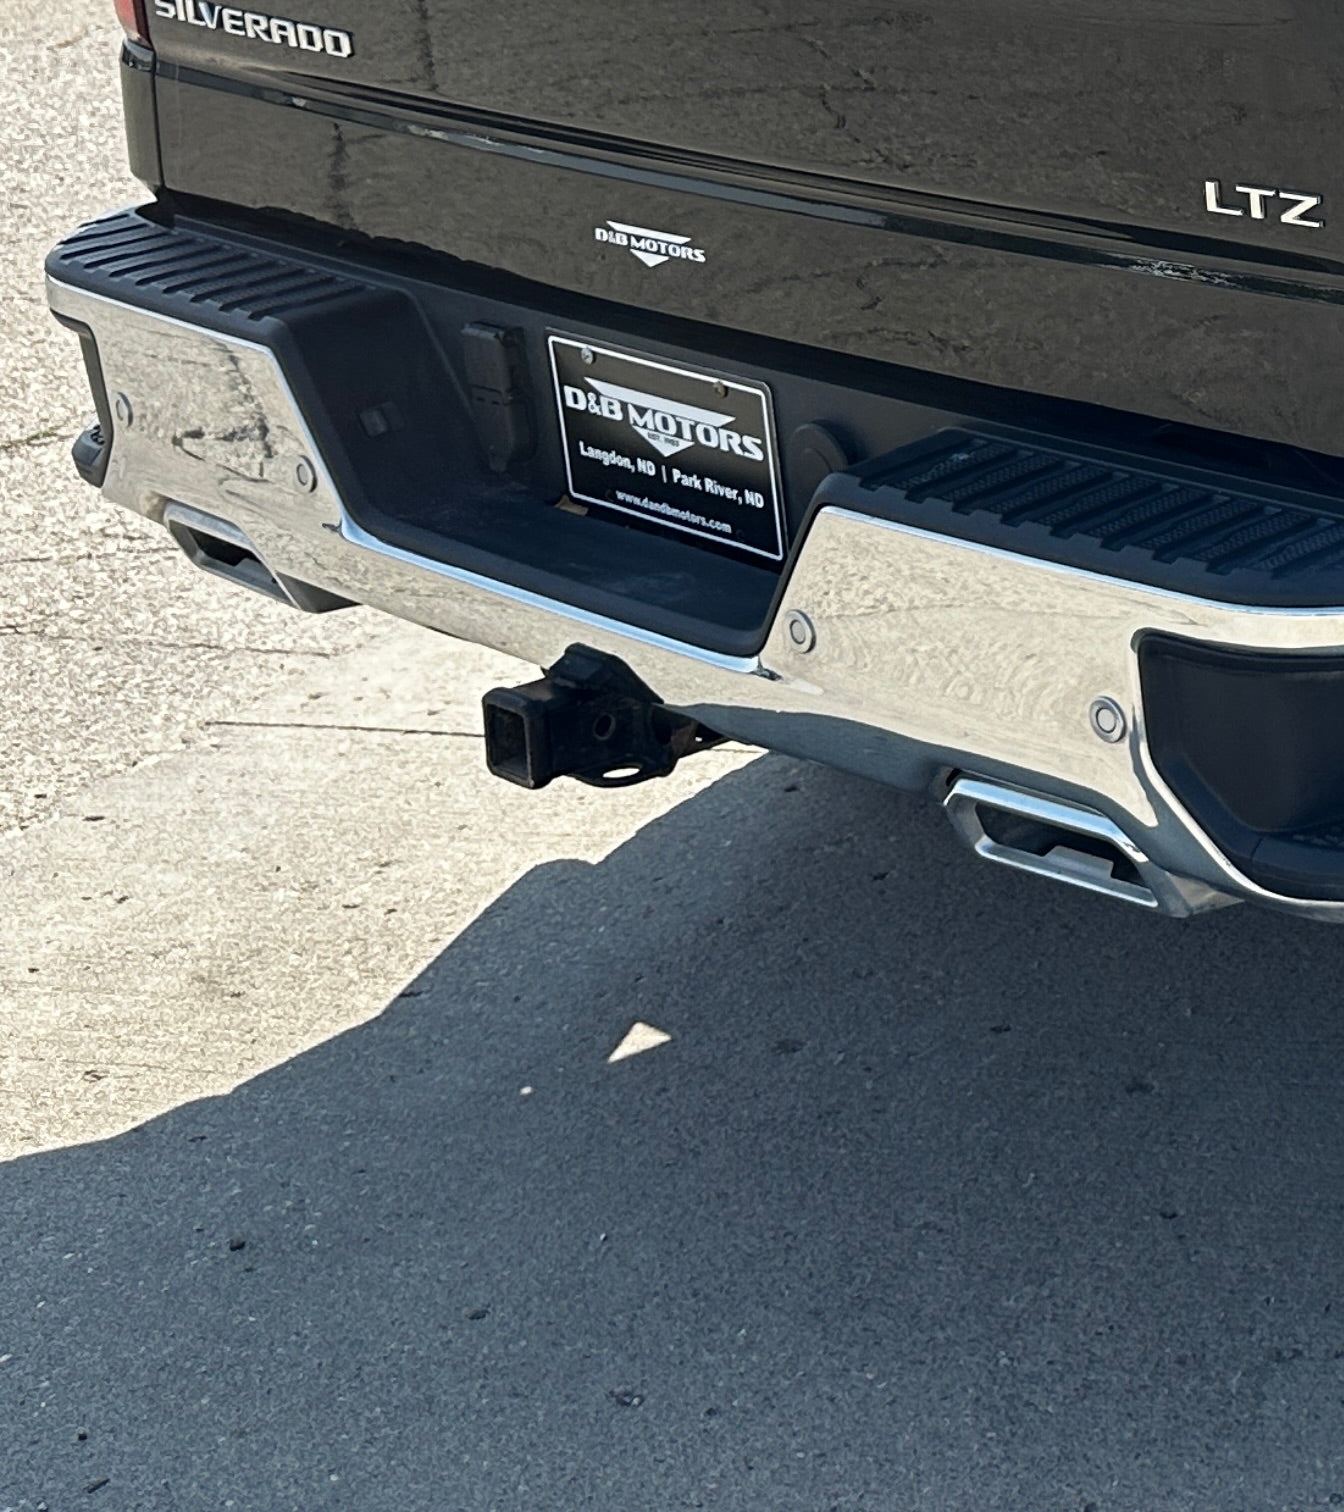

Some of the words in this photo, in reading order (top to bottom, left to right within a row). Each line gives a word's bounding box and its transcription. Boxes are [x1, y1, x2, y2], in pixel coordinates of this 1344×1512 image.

[1205, 180, 1324, 228] LTZ
[595, 227, 628, 246] D&B
[630, 235, 706, 262] MOTORS
[564, 385, 623, 421] D&B
[628, 404, 764, 461] MOTORS
[579, 441, 635, 473] Langdon,
[636, 458, 656, 476] ND
[672, 468, 702, 490] Park
[704, 480, 743, 506] River,
[745, 489, 765, 509] ND
